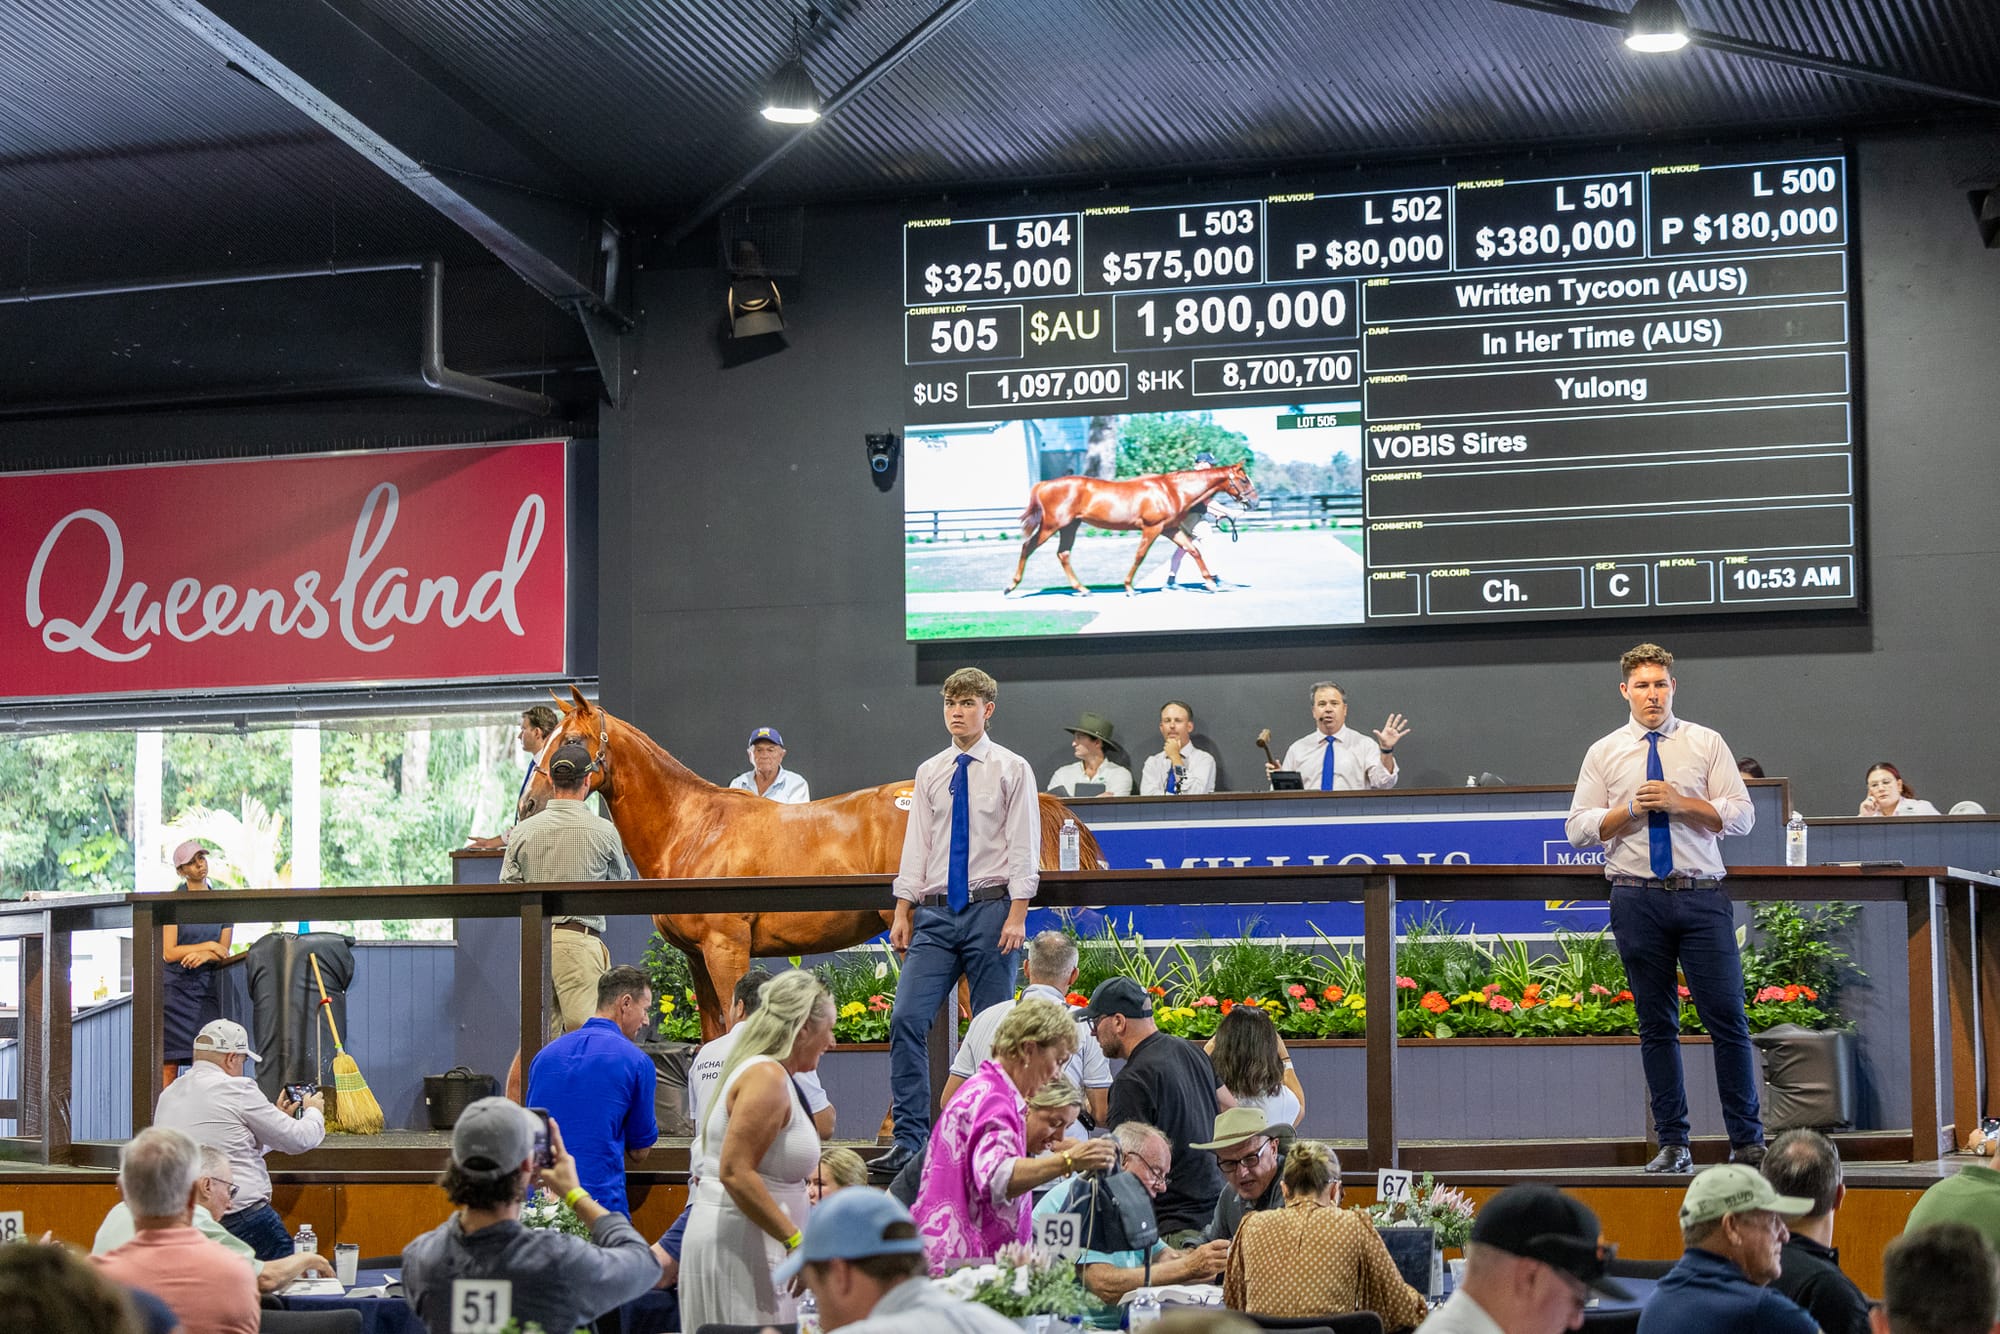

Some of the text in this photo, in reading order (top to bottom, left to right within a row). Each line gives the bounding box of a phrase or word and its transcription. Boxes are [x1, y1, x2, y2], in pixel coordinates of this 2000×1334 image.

[1556, 180, 1633, 212] L 501
[1753, 166, 1836, 197] L 500
[1178, 208, 1254, 238] L 503
[1364, 195, 1443, 226] L 502
[1661, 206, 1838, 245] P $180,000
[988, 218, 1071, 251] L 504
[1475, 218, 1637, 262] $380,000
[1102, 244, 1254, 286] $575,000
[1296, 234, 1444, 271] P $80,000
[924, 256, 1072, 298] $325,000
[1455, 266, 1748, 308] Written Tycoon (AUS)
[1030, 308, 1100, 346] $AU
[1136, 288, 1347, 344] 1,800,000
[930, 317, 999, 354] 505
[1482, 317, 1723, 356] In Her Time (AUS)
[996, 368, 1123, 404] 1,097,000
[1136, 368, 1185, 394] $HK
[1222, 355, 1354, 393] 8,700,700
[1554, 375, 1648, 402] Yulong
[913, 381, 959, 407] $US
[1296, 414, 1337, 429] LOT 505
[1372, 431, 1528, 460] VOBIS Sires
[25, 481, 546, 663] Queensland
[1373, 571, 1406, 580] ONLINE
[1431, 569, 1470, 578] COLOUR
[1595, 562, 1616, 570] SEX
[1724, 556, 1748, 565] TIME
[1482, 578, 1529, 603] Ch.
[1608, 573, 1631, 598] C
[1732, 565, 1841, 590] 10:53 AM
[1556, 851, 1608, 866] MAGIC
[701, 1071, 721, 1081] PHO
[1383, 1175, 1406, 1197] 67
[0, 1218, 17, 1240] 8
[1043, 1221, 1075, 1247] 59
[462, 1290, 498, 1325] 51
